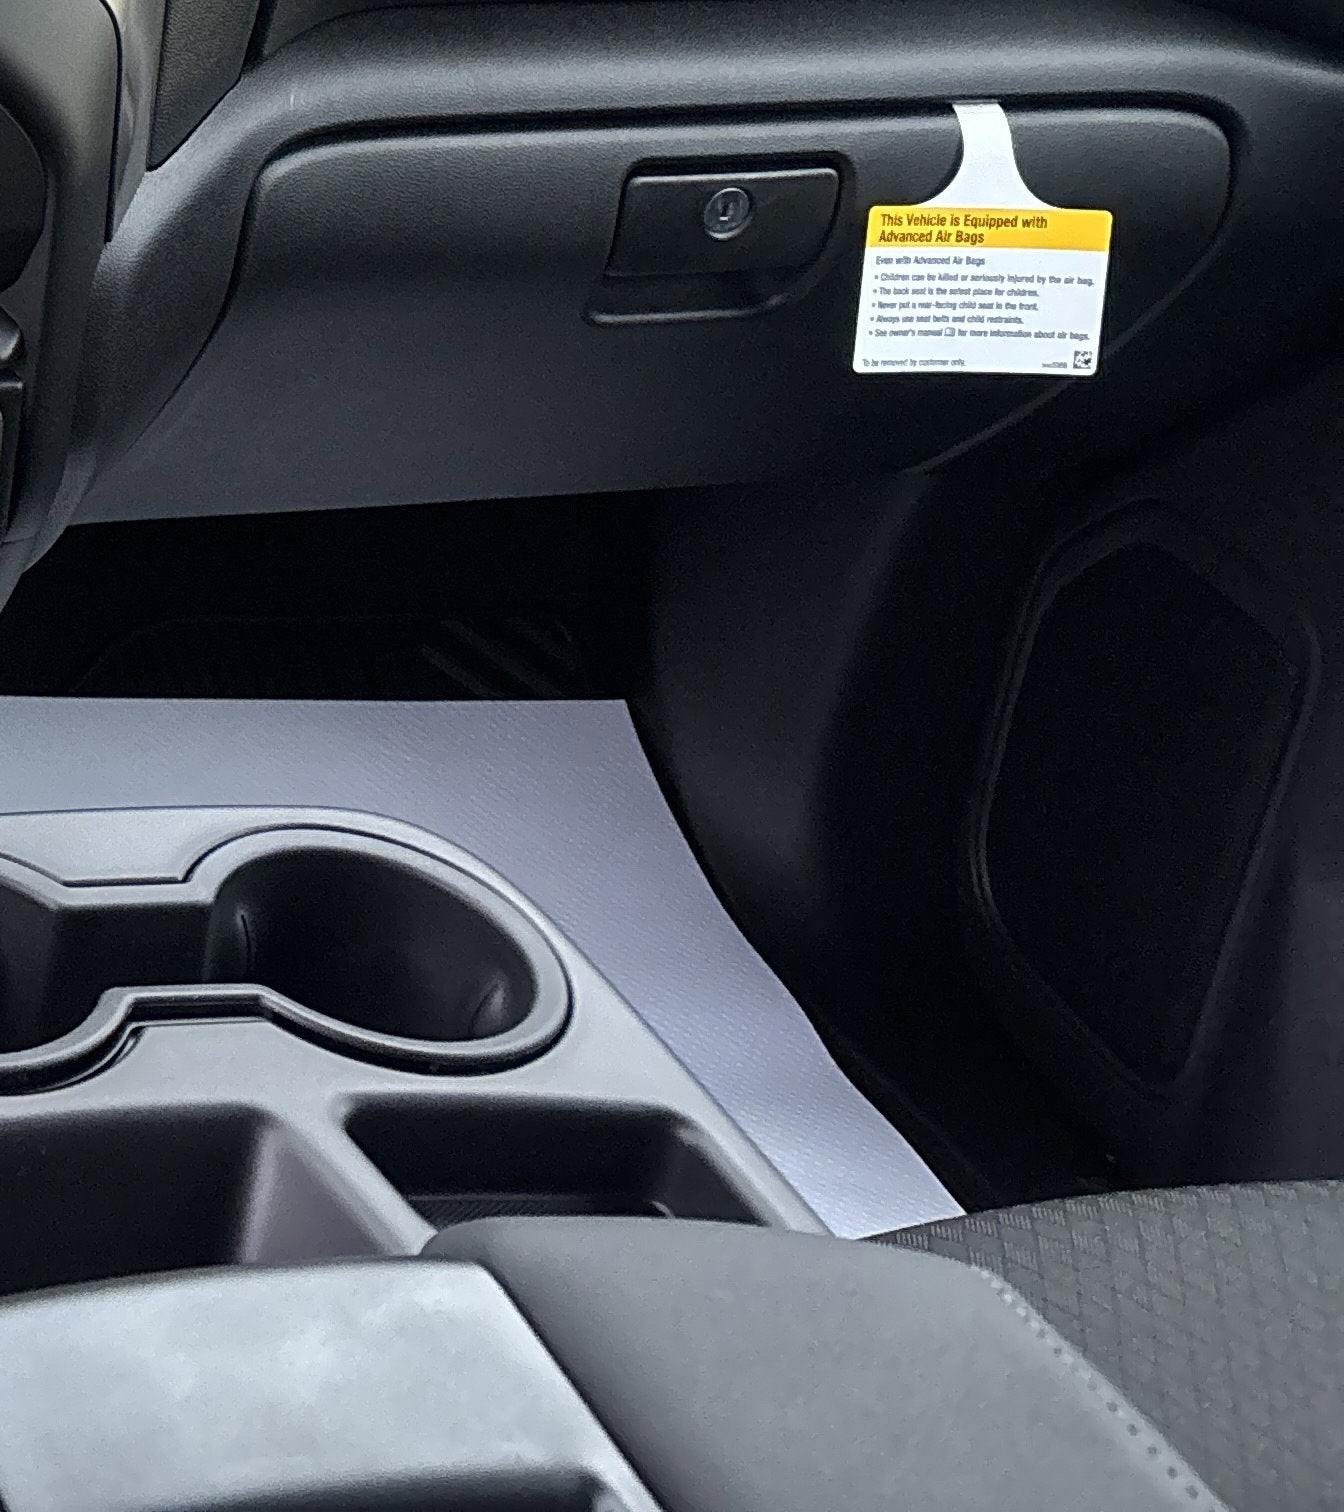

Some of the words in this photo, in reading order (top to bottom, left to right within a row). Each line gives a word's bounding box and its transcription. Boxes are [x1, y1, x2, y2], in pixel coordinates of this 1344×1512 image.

[880, 214, 903, 226] This
[906, 214, 947, 226] Vehicle
[950, 214, 960, 227] is
[964, 214, 1018, 230] Equipped
[1021, 216, 1048, 228] with
[878, 230, 932, 242] Advanced
[935, 230, 952, 242] Air
[955, 231, 984, 245] Bags
